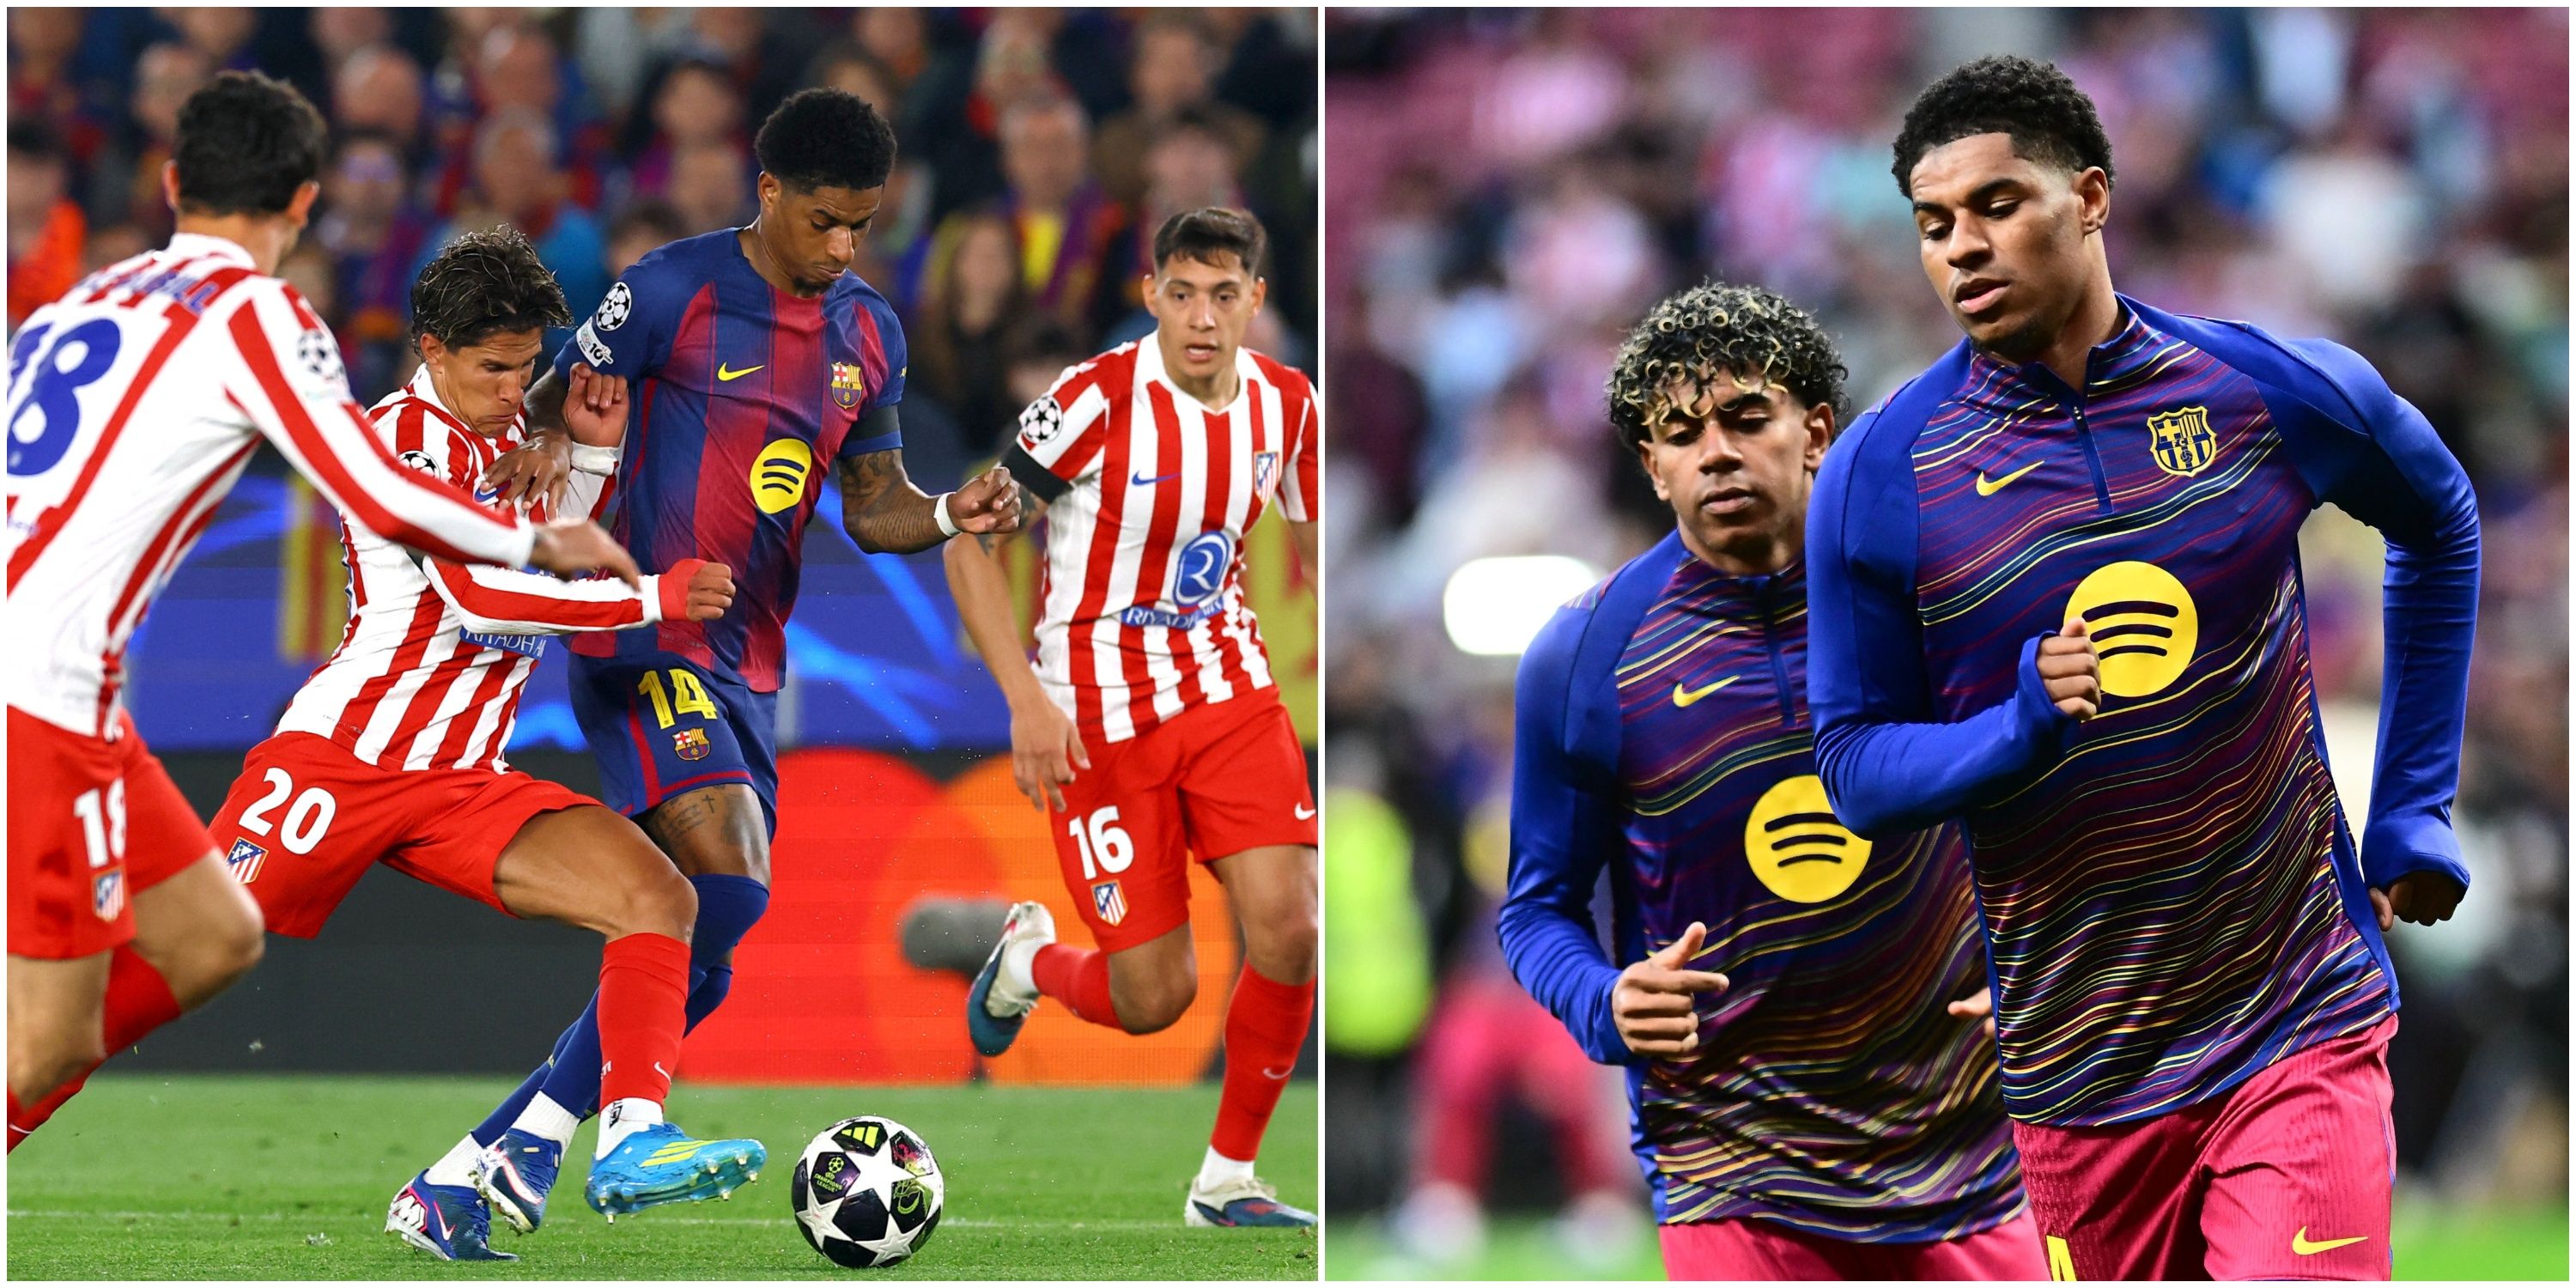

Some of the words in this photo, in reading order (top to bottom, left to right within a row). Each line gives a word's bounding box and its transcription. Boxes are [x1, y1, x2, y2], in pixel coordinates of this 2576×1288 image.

[2172, 437, 2194, 447] FCB
[638, 668, 717, 730] 14
[73, 776, 126, 869] 18
[238, 767, 337, 855] 20
[1068, 805, 1134, 880] 16
